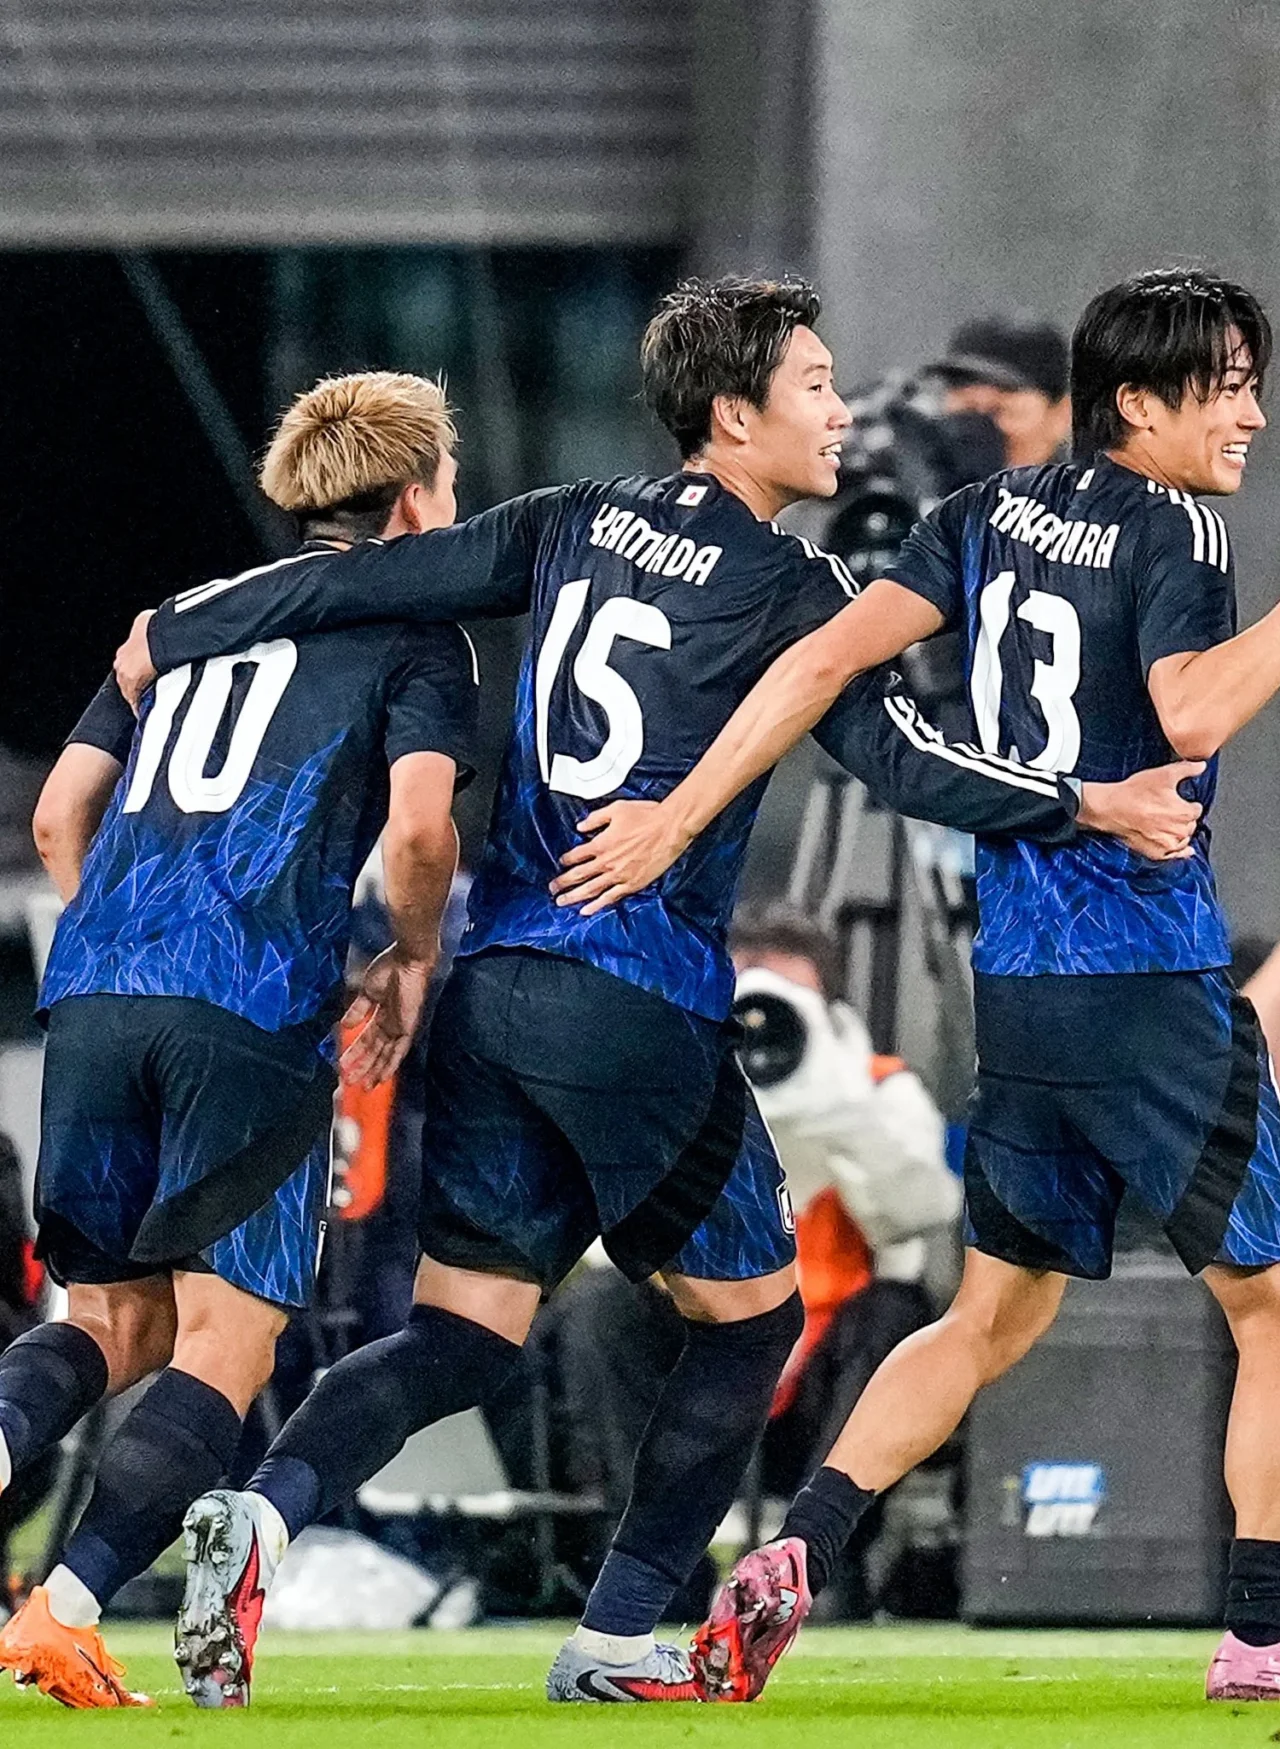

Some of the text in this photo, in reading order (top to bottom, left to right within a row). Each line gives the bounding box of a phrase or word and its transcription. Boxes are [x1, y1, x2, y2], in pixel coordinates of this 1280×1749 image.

[122, 637, 298, 814] 10
[535, 577, 672, 800] 15
[970, 570, 1081, 774] 13
